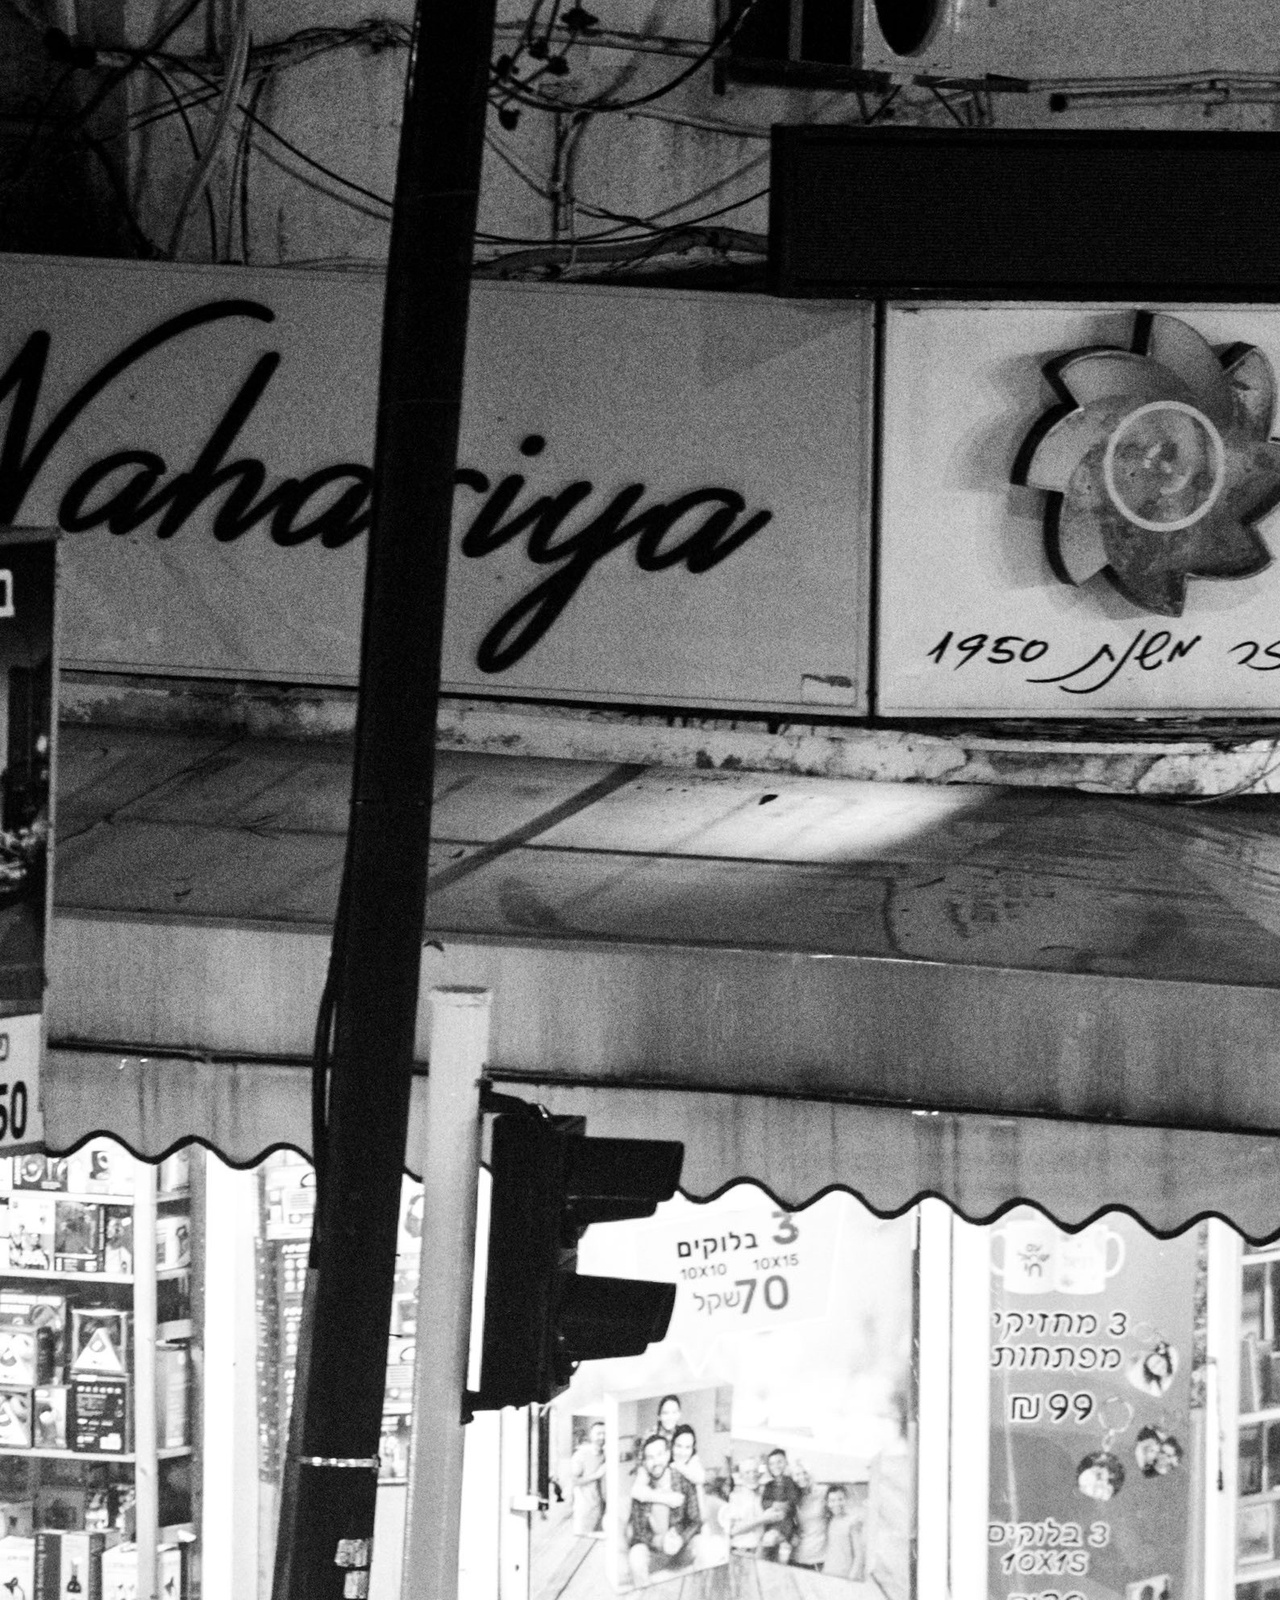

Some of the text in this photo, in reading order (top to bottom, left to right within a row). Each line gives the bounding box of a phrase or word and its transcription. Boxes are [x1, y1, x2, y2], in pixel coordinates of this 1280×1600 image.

[927, 630, 1049, 671] 1950
[1026, 628, 1202, 694] משנת
[677, 1210, 800, 1260] 3 בלוקים
[692, 1274, 790, 1316] 70 שקל
[993, 1312, 1127, 1340] 3 מחזיקי
[991, 1346, 1122, 1369] מפתחות
[988, 1519, 1108, 1546] 3 בלוקים
